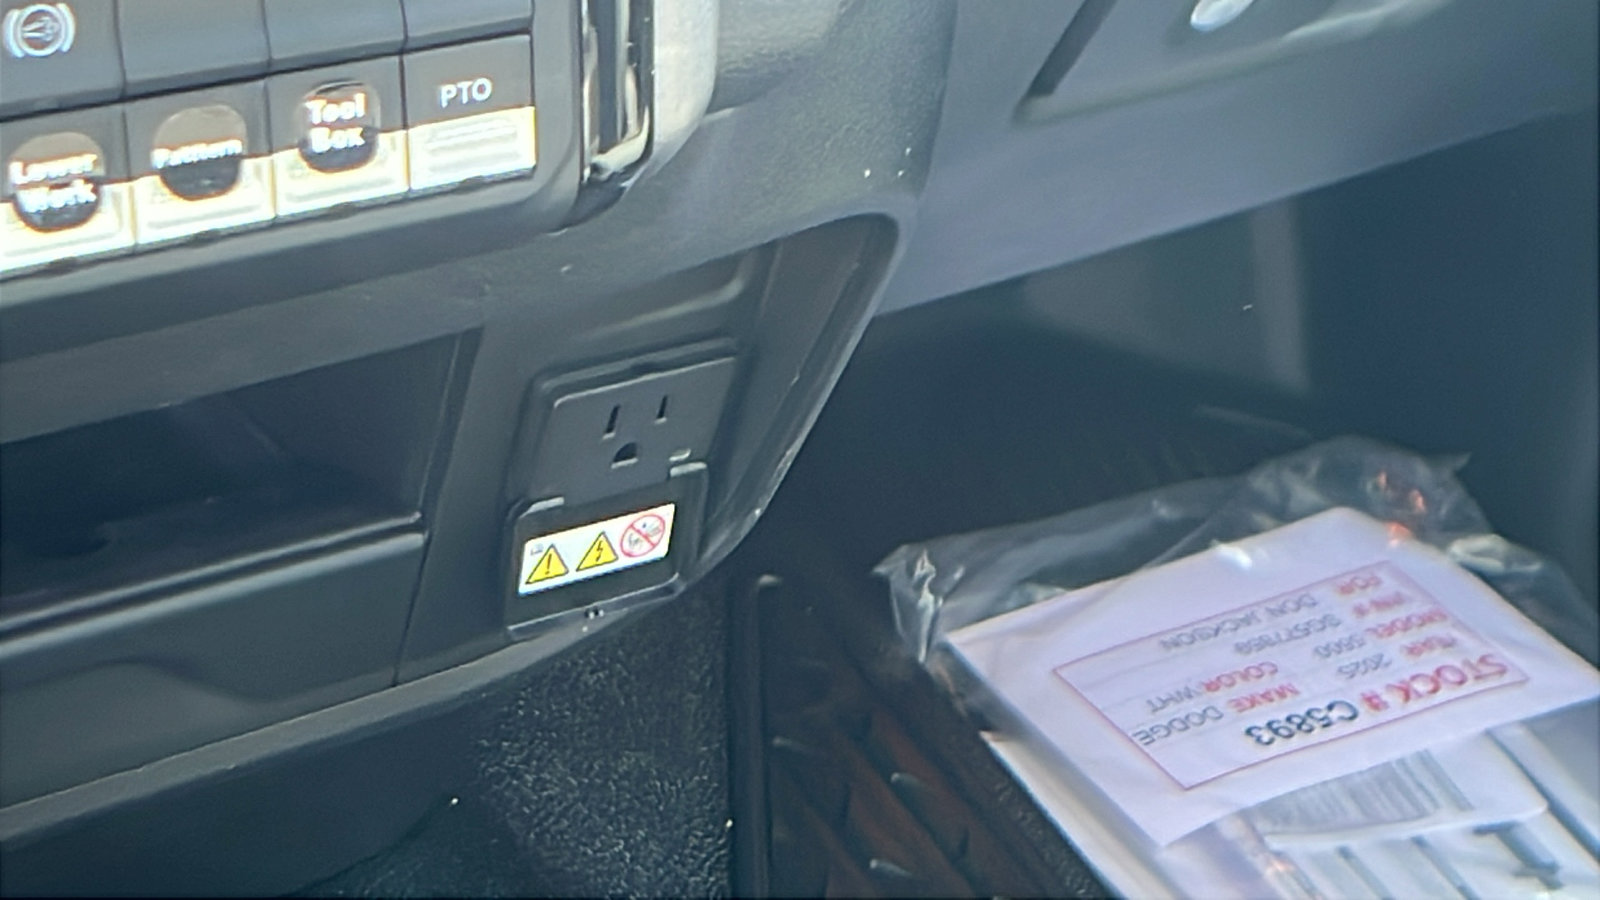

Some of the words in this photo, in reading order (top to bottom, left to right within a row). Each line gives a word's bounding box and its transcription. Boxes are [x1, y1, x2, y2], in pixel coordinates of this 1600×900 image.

[440, 77, 493, 108] PTO
[304, 92, 366, 125] Tool
[308, 126, 366, 154] Box
[9, 154, 97, 185] Lower
[17, 180, 97, 213] Work
[1337, 573, 1381, 594] FOR
[1267, 593, 1318, 617] DON
[1160, 611, 1261, 651] JACKSON
[1368, 608, 1447, 638] MODEL
[1201, 661, 1279, 691] COLOR
[1338, 653, 1392, 678] 2025
[1387, 653, 1508, 705] STOCK
[1146, 686, 1200, 711] WHT
[1230, 682, 1299, 712] MAKE
[1359, 690, 1389, 711] #
[1133, 705, 1223, 745] DODGE
[1245, 700, 1359, 746] C5893
